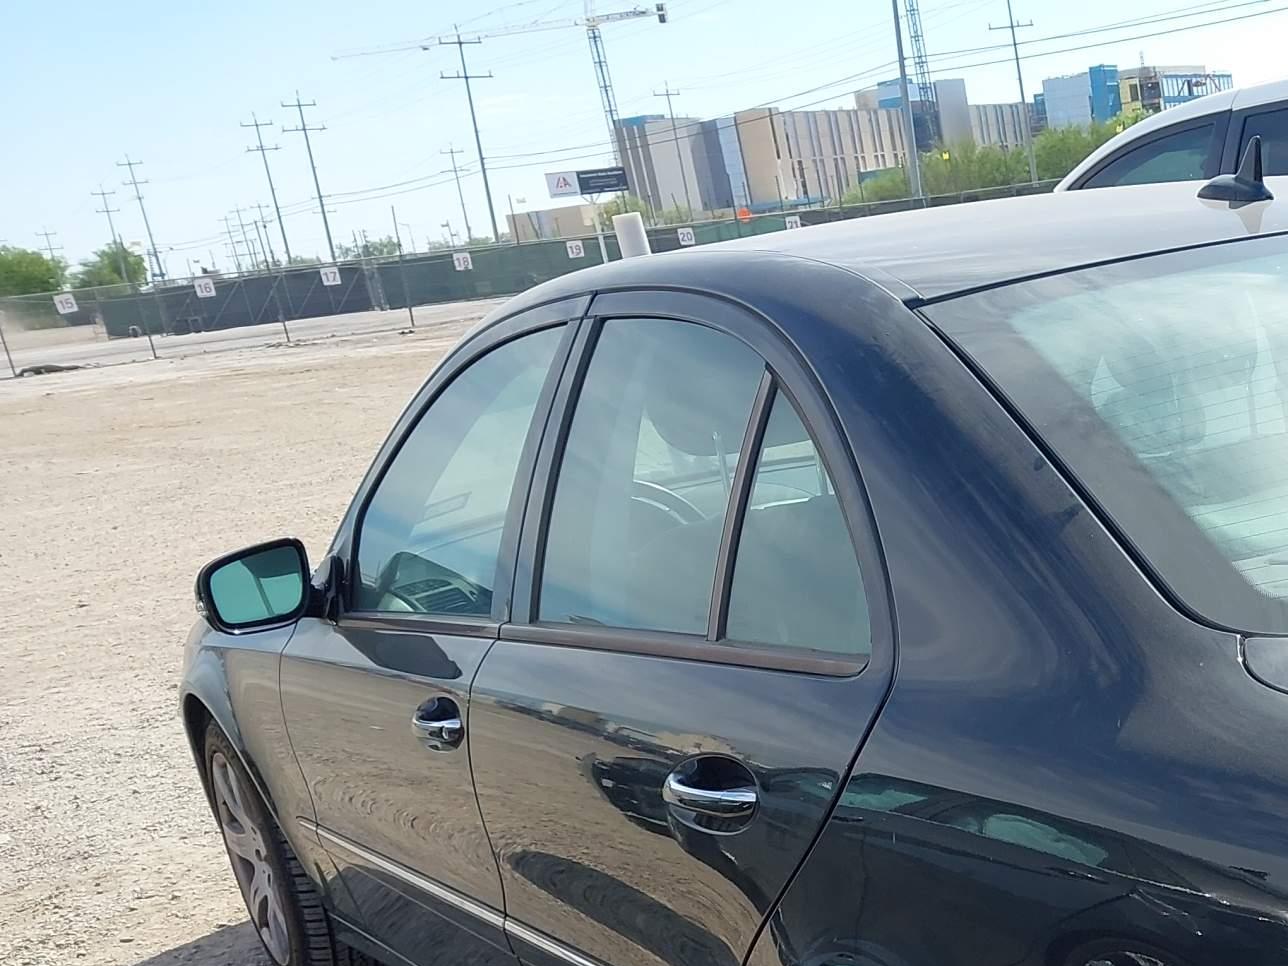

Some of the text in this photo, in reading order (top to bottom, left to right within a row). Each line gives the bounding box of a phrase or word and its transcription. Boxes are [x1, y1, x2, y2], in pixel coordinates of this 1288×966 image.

[679, 231, 693, 242] 20
[568, 244, 582, 256] 19
[455, 256, 470, 267] 18
[322, 271, 337, 282] 17
[197, 282, 212, 294] 16
[58, 298, 73, 311] 15
